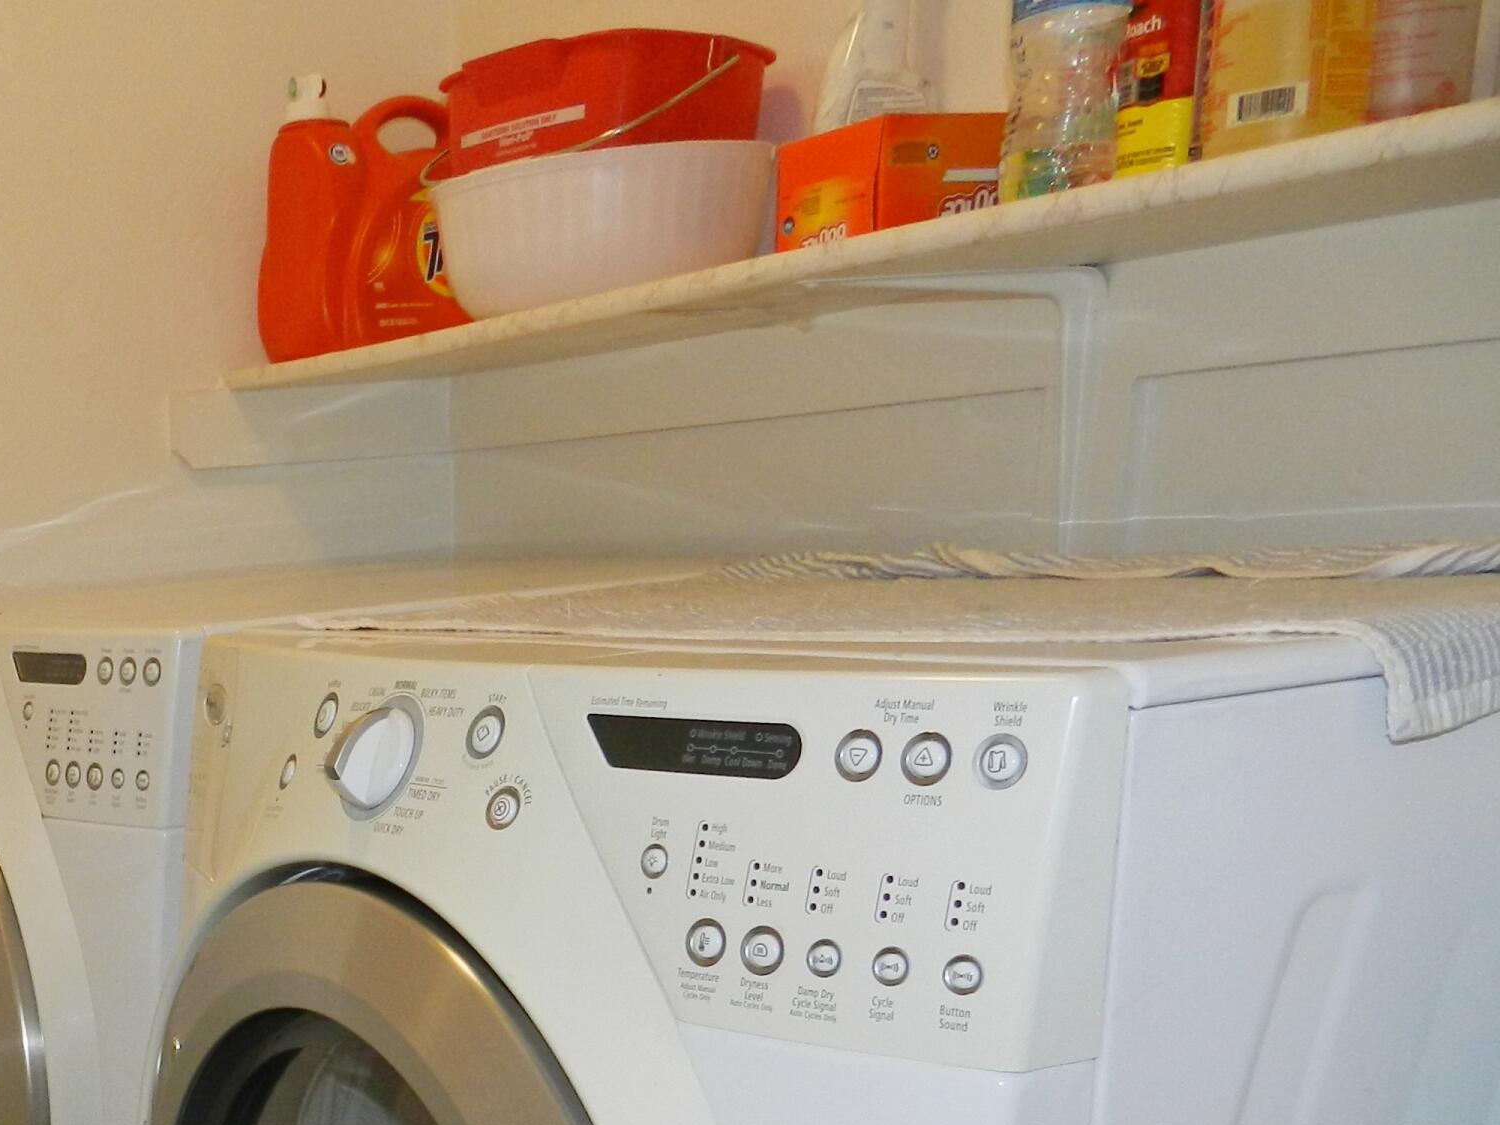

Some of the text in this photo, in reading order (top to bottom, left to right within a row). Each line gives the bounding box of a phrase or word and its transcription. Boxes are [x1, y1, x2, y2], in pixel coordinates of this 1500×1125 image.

[874, 699, 935, 713] Adjust Manual
[993, 702, 1028, 713] Wrinkle
[884, 712, 919, 726] Dry Time
[994, 716, 1022, 727] Shield
[903, 794, 943, 807] OPTIONS
[711, 822, 728, 835] High
[708, 840, 736, 852] Medium
[705, 857, 719, 868] Low
[763, 863, 783, 874] More
[701, 873, 736, 886] Extra Low
[827, 870, 847, 881] Loud
[760, 879, 790, 892] Normal
[898, 877, 919, 888] Loud
[711, 889, 727, 904] Only
[824, 886, 840, 898] Soft
[969, 884, 992, 896] Loud
[756, 897, 772, 908] Less
[894, 894, 912, 906] Soft
[820, 903, 834, 914] Off
[966, 901, 985, 914] Soft
[891, 911, 905, 924] Off
[963, 919, 978, 931] Off
[677, 967, 720, 983] Temperature
[740, 977, 769, 991] Dryness
[744, 991, 764, 1002] Level
[797, 986, 835, 1001] Damp Dry
[792, 997, 837, 1013] Cycle Signal
[871, 995, 894, 1009] Cycle
[868, 1008, 894, 1022] Signal
[940, 1004, 971, 1019] Button
[939, 1018, 968, 1032] Sound
